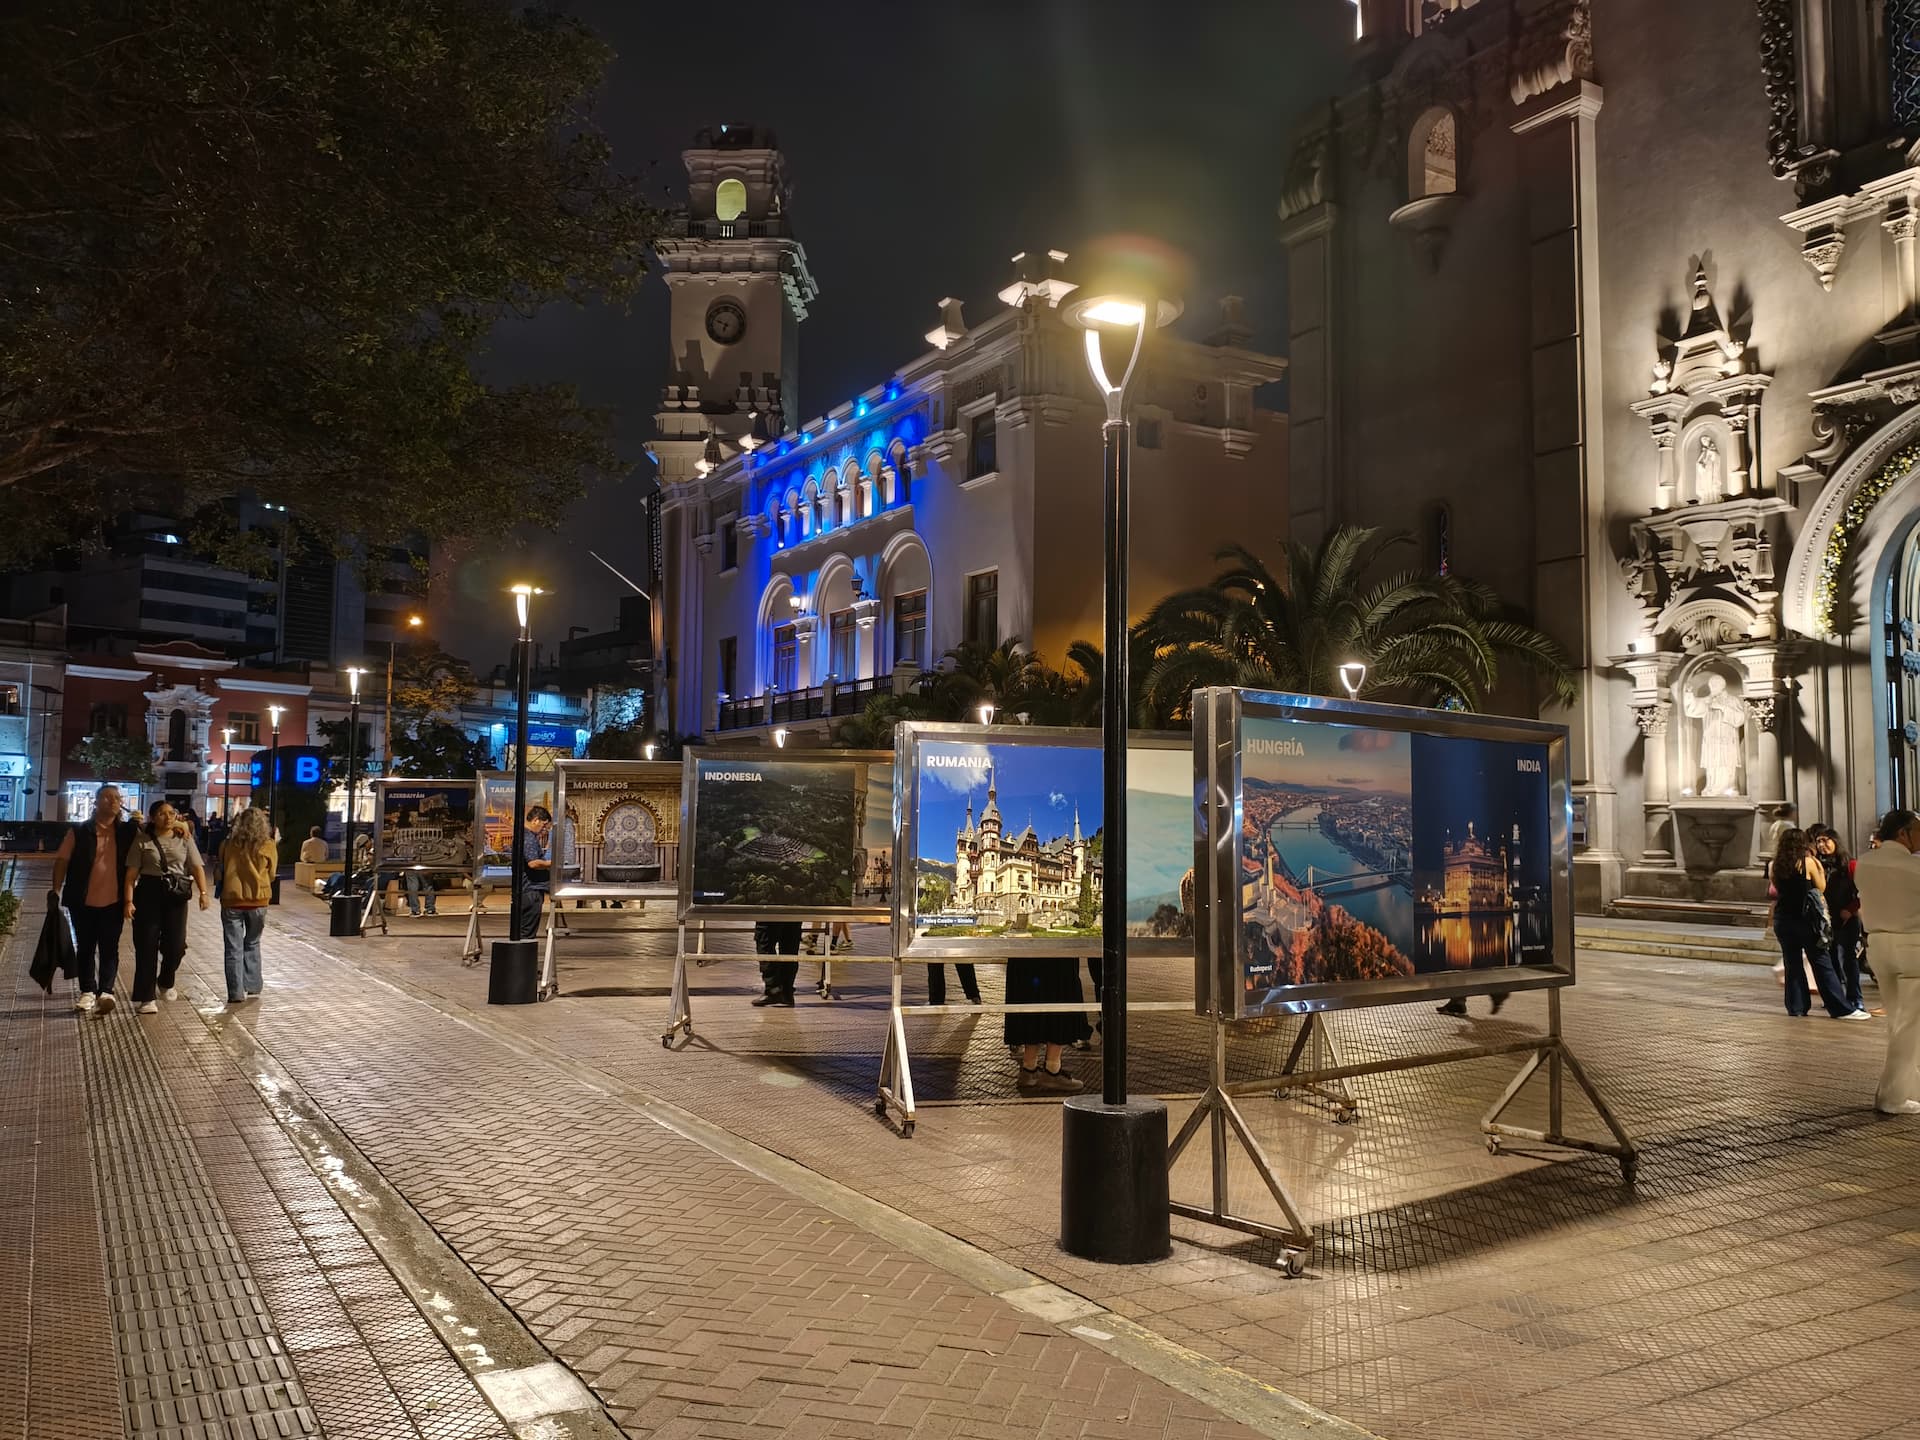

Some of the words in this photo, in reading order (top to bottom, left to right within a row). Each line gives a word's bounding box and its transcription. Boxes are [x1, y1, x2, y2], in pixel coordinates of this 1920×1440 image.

[1246, 737, 1304, 757] HUNGRÍA
[926, 755, 992, 769] RUMANIA
[1516, 759, 1542, 773] INDIA
[704, 771, 763, 782] INDONESIA
[573, 781, 629, 790] MARRUECOS
[1249, 965, 1273, 973] Budapest
